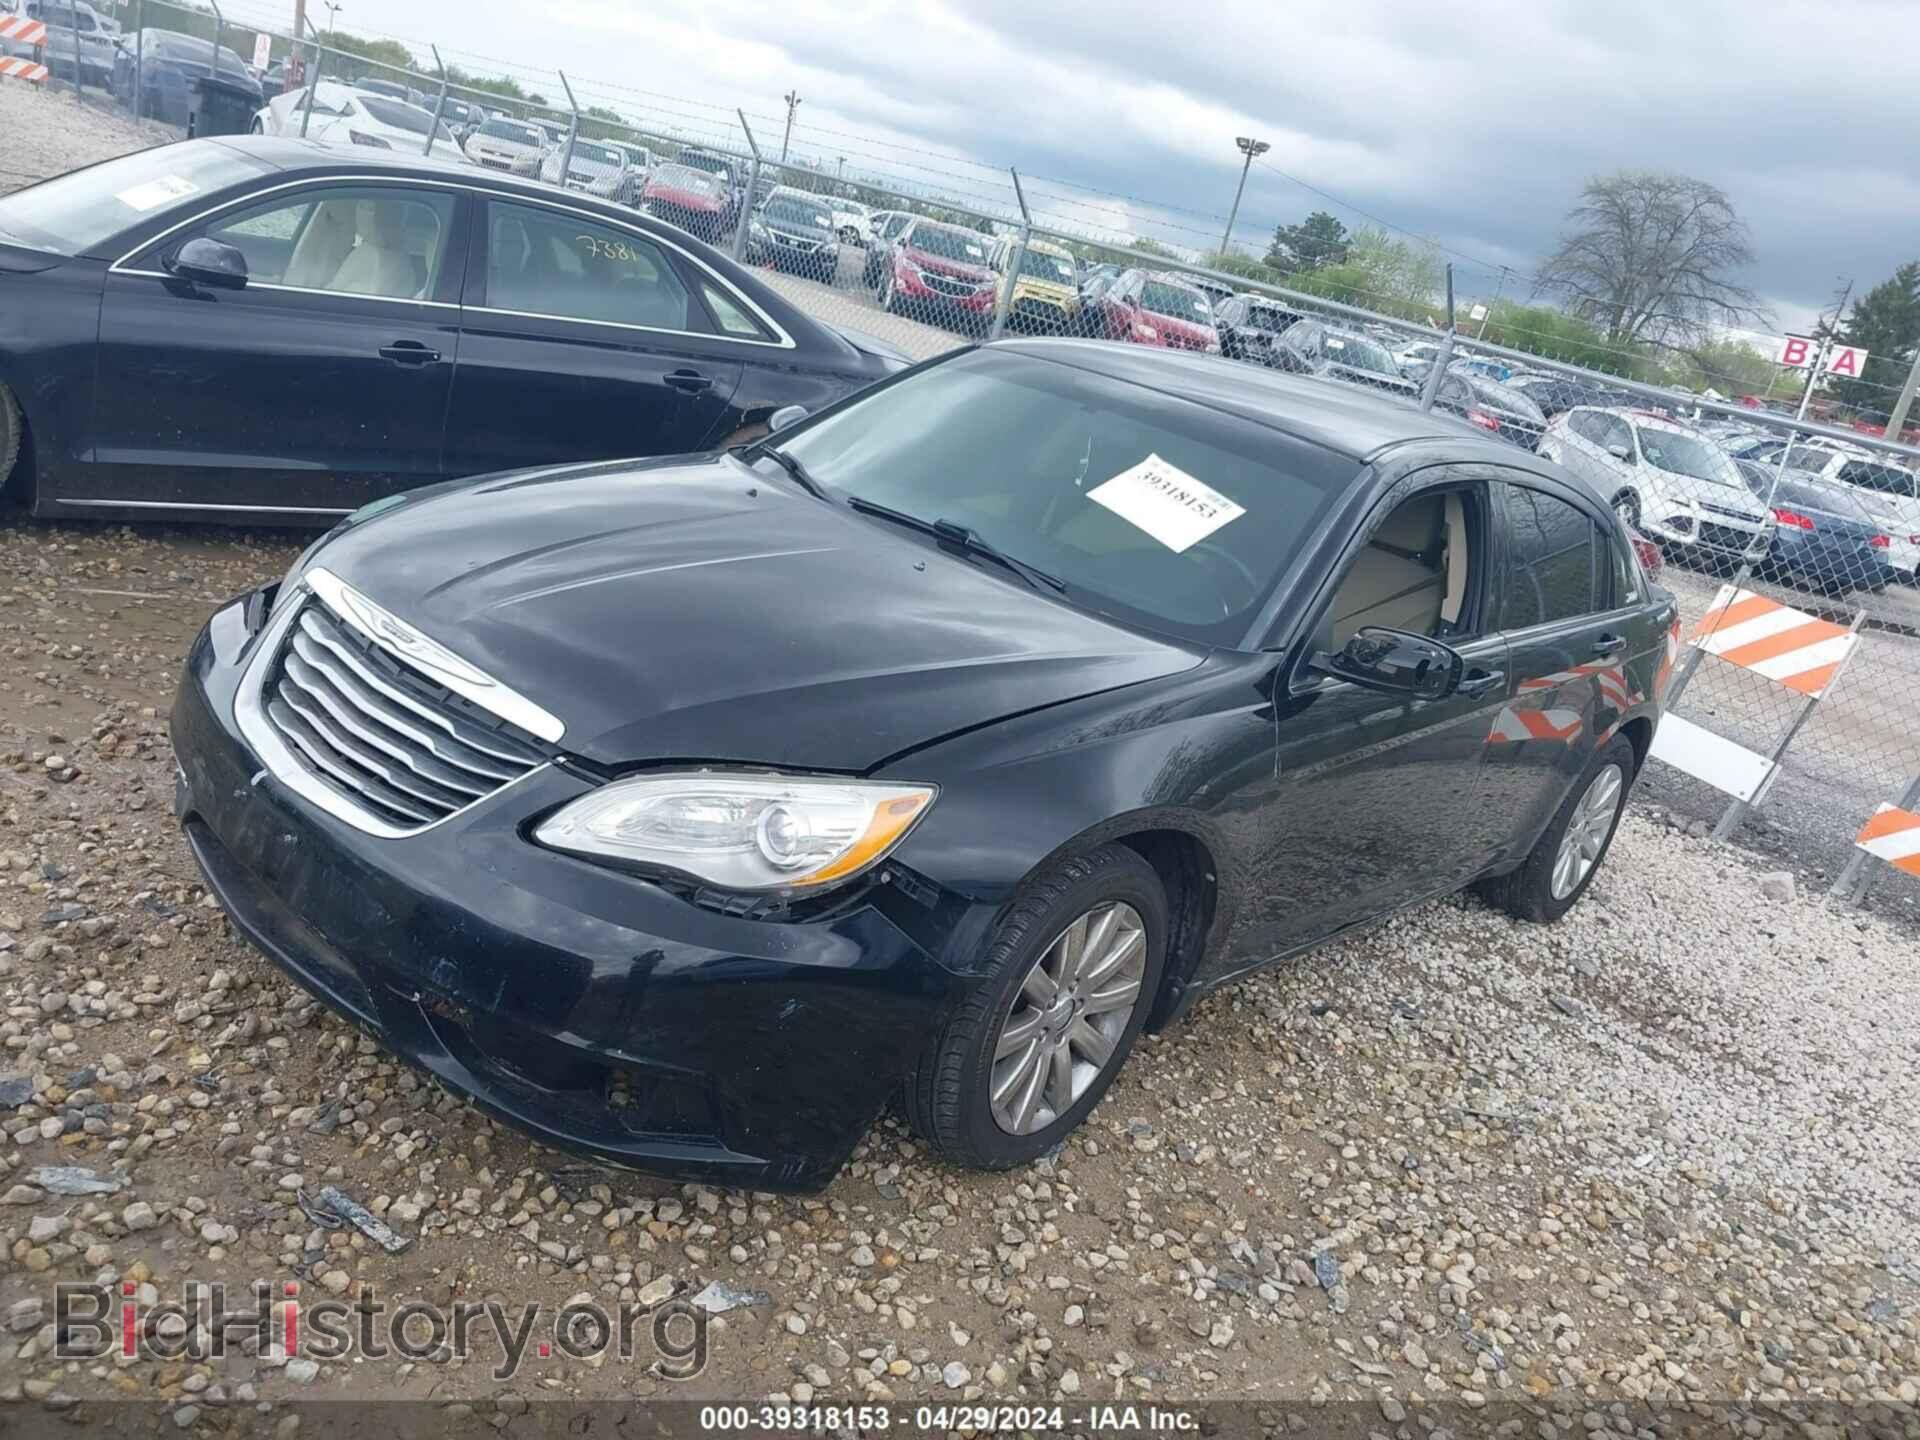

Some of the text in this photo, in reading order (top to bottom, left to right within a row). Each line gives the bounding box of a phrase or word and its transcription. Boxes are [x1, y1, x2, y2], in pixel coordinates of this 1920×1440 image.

[1782, 338, 1809, 365] B
[1831, 348, 1856, 376] A
[1137, 471, 1218, 519] 39318153
